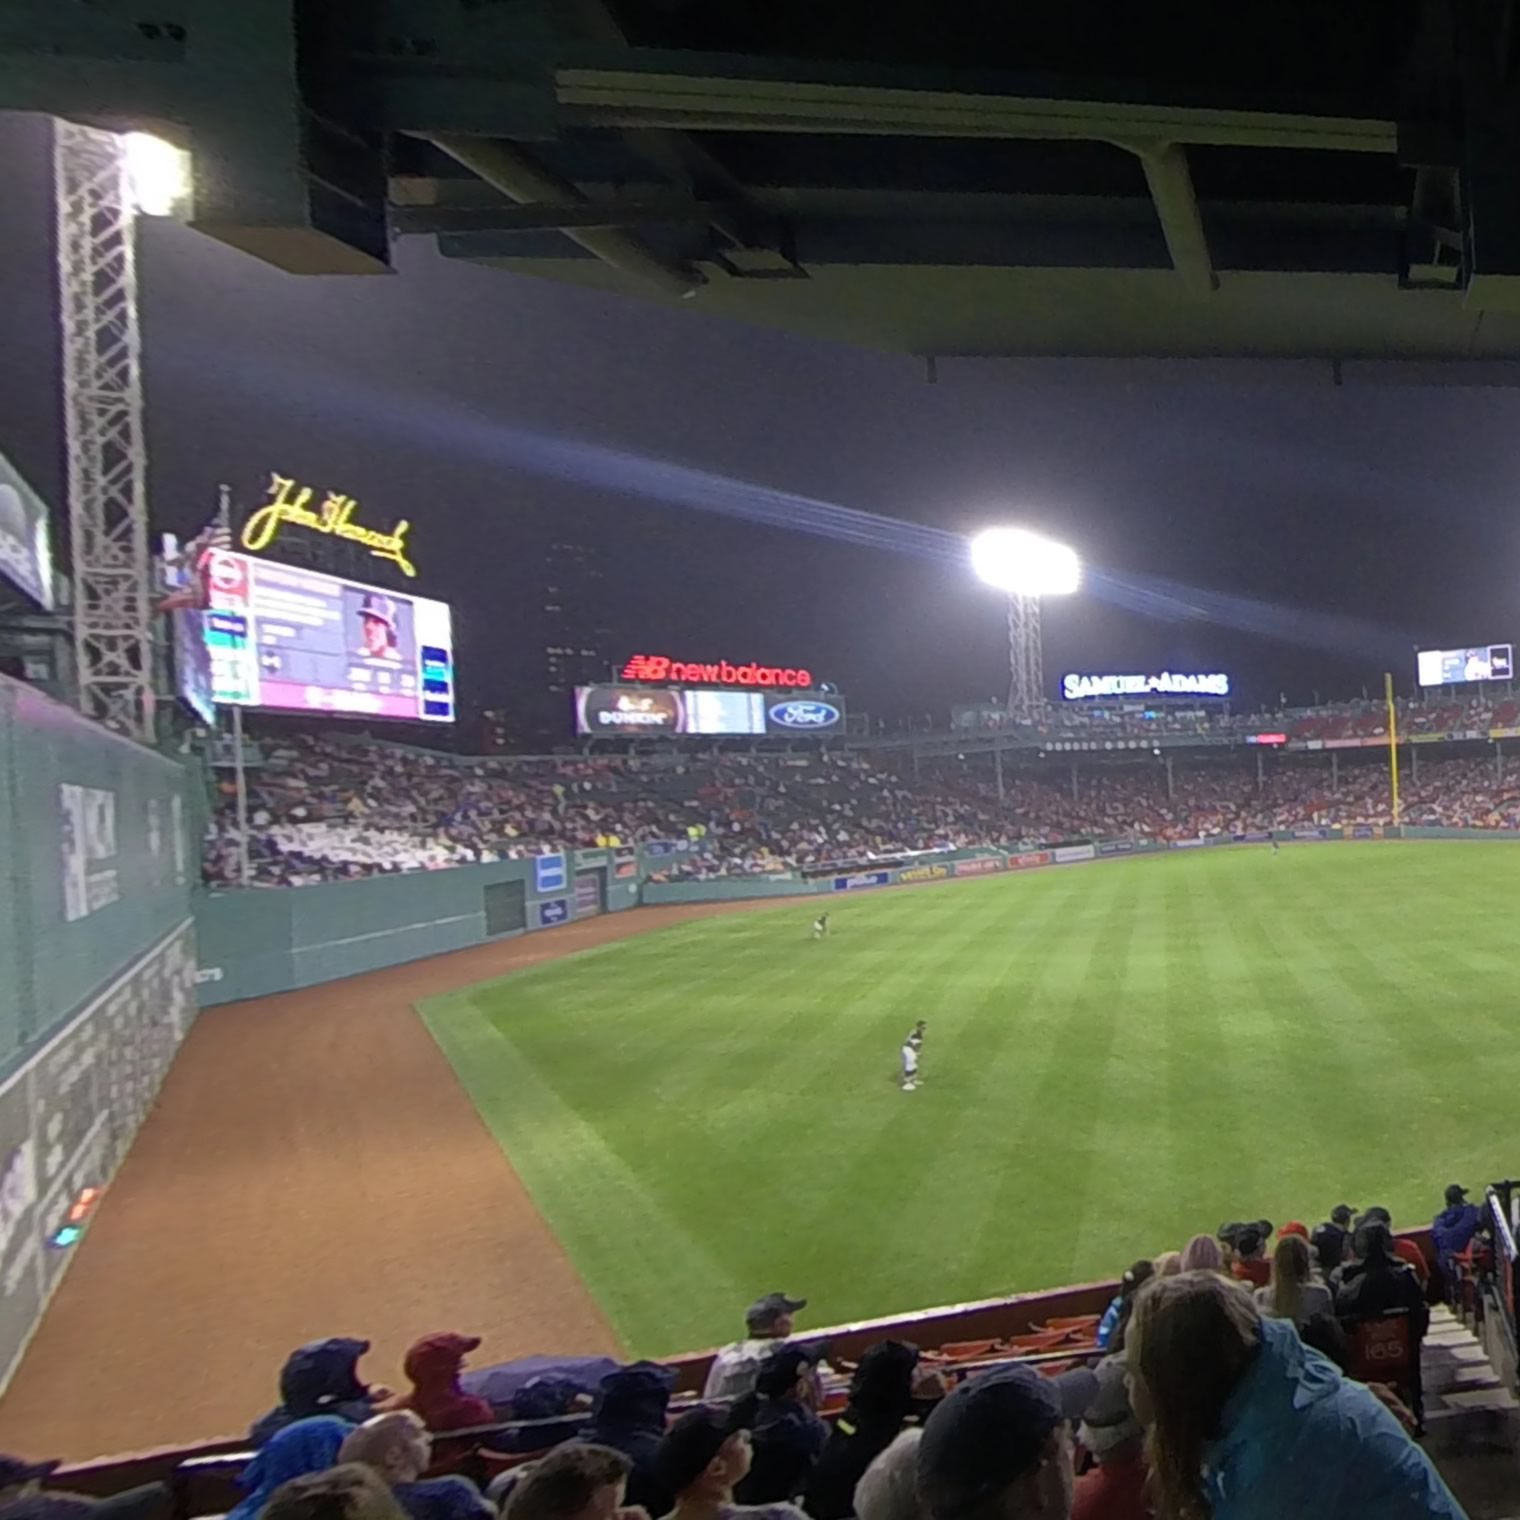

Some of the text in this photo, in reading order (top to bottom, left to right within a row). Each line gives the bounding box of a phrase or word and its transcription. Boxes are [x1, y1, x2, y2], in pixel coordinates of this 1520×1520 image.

[241, 472, 416, 577] John Hancock
[1063, 671, 1229, 699] SAMUEL ADAMS
[782, 704, 827, 724] Ford
[1364, 1341, 1404, 1361] 165
